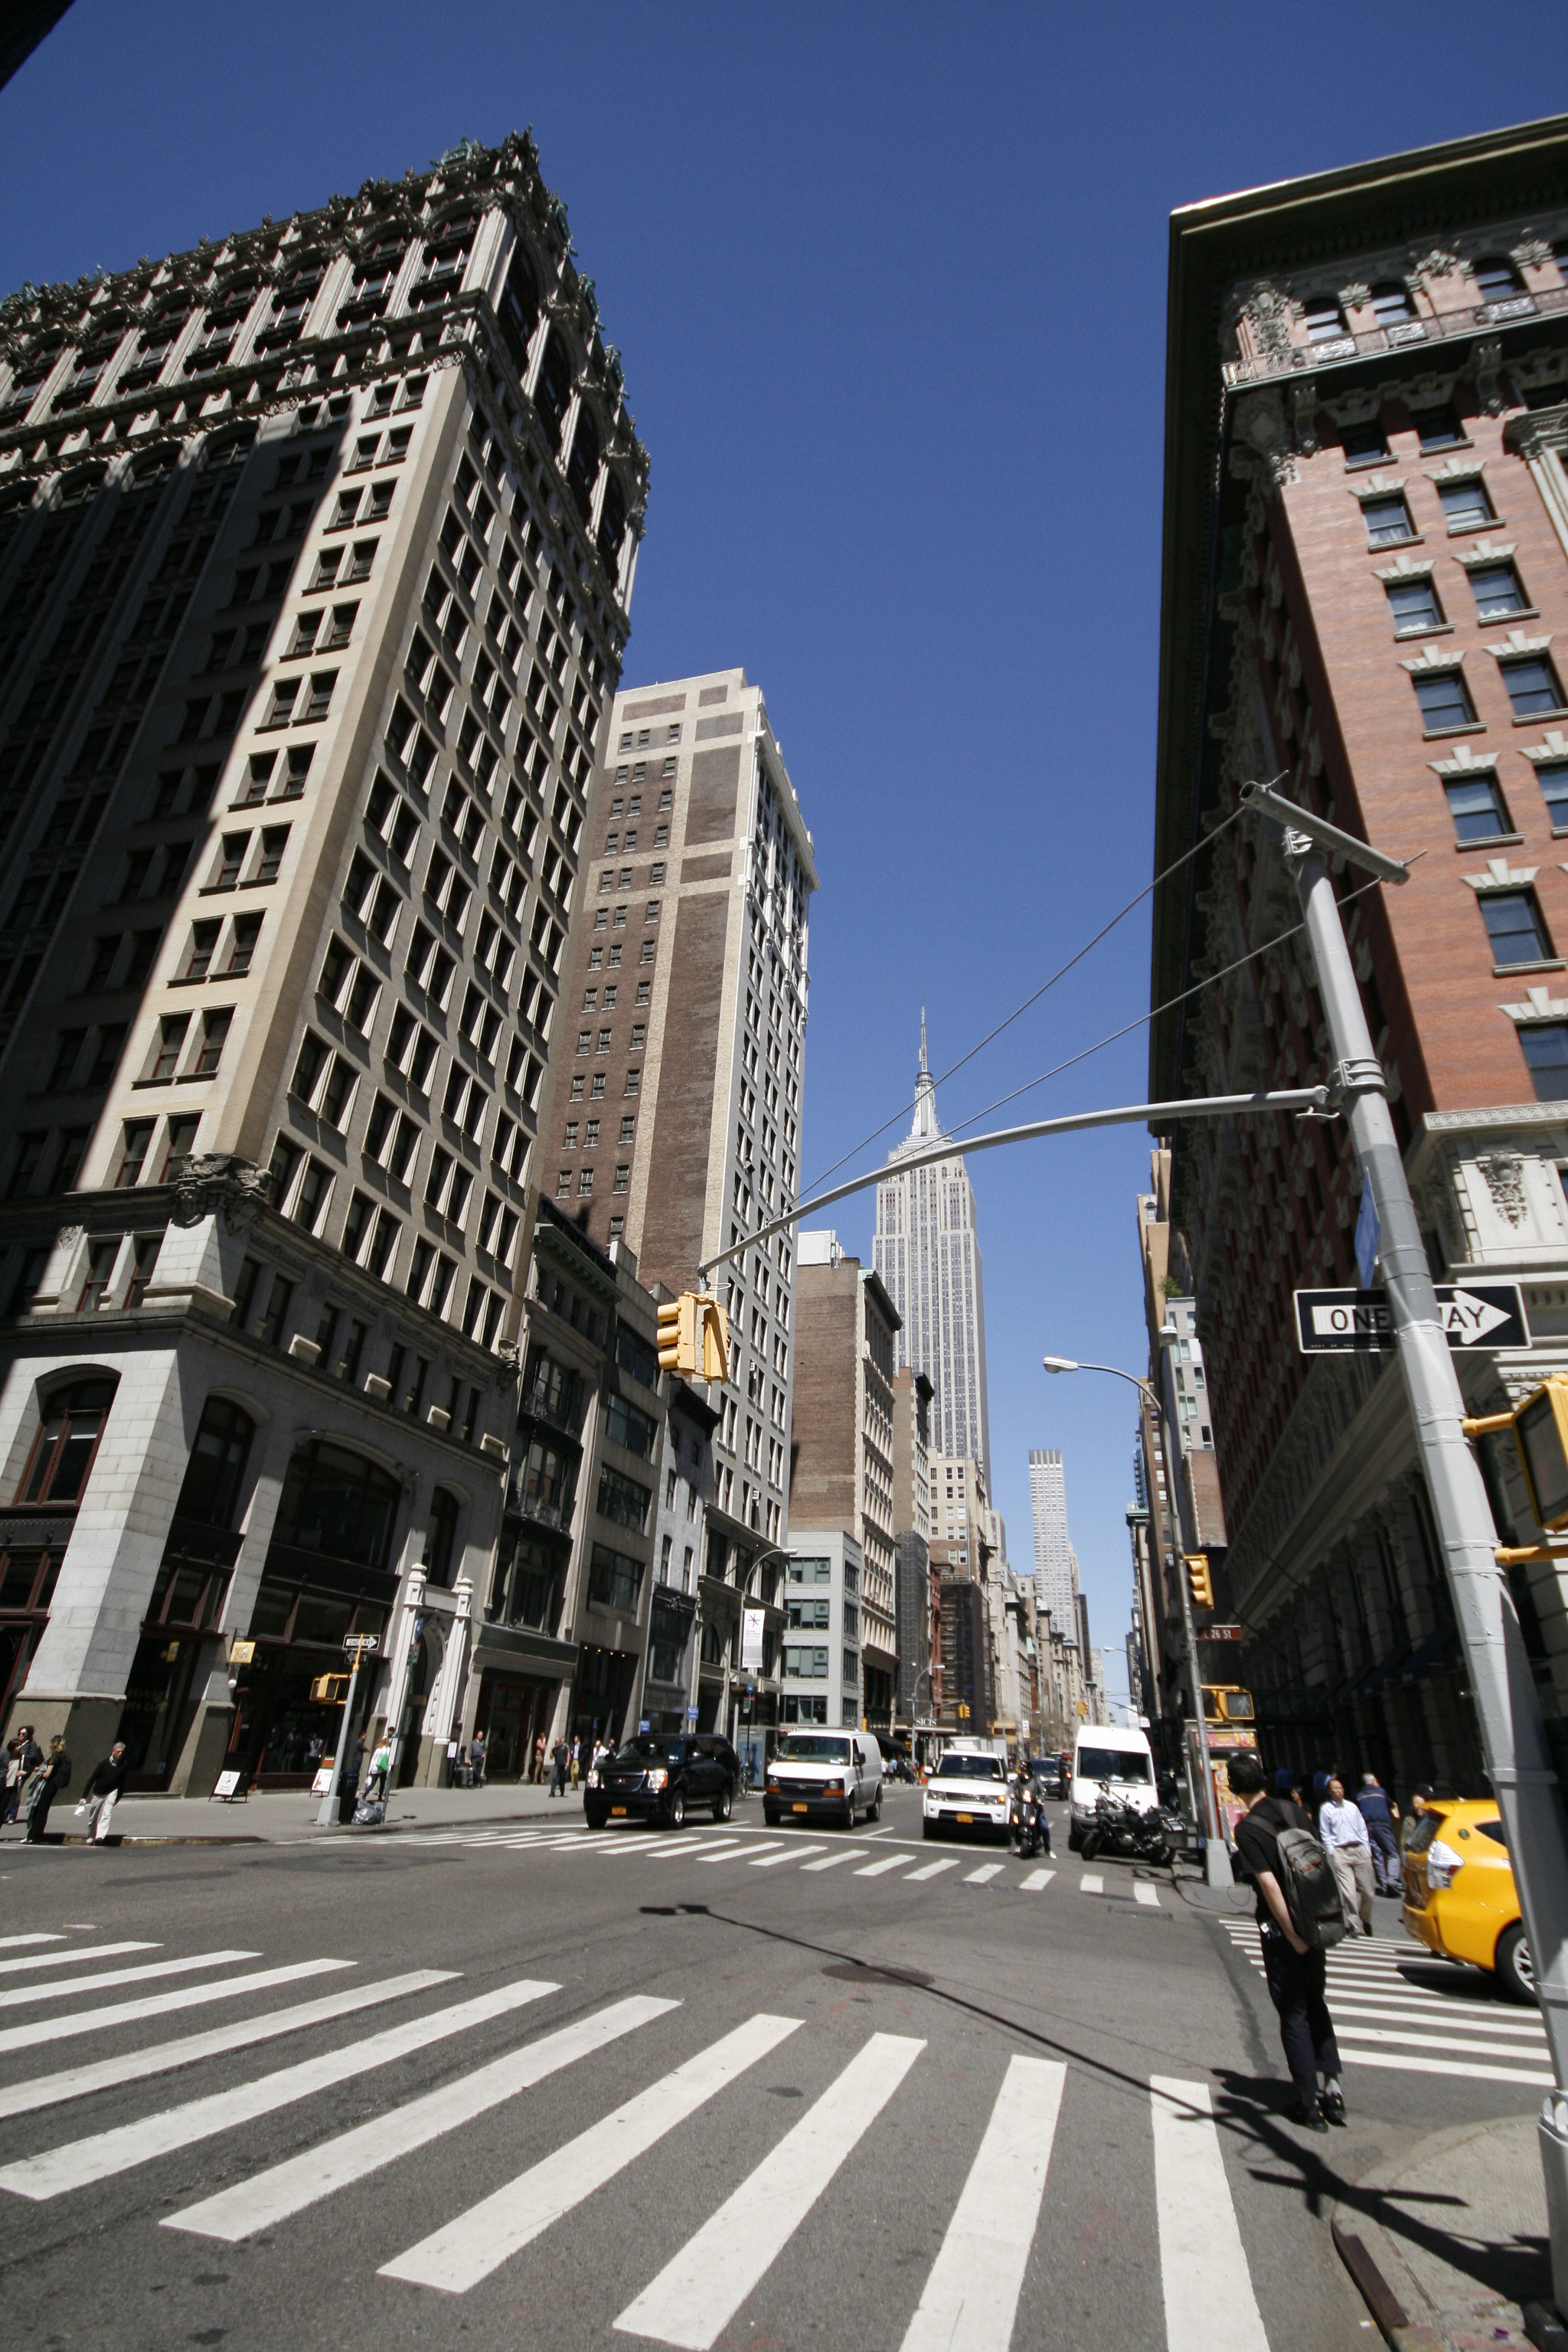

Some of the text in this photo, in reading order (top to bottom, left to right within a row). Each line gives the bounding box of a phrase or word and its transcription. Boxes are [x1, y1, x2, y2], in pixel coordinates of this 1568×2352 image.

[1330, 1305, 1485, 1331] ONE AY
[1211, 1628, 1221, 1638] 26
[1223, 1628, 1232, 1638] St
[916, 1717, 937, 1726] SICIS
